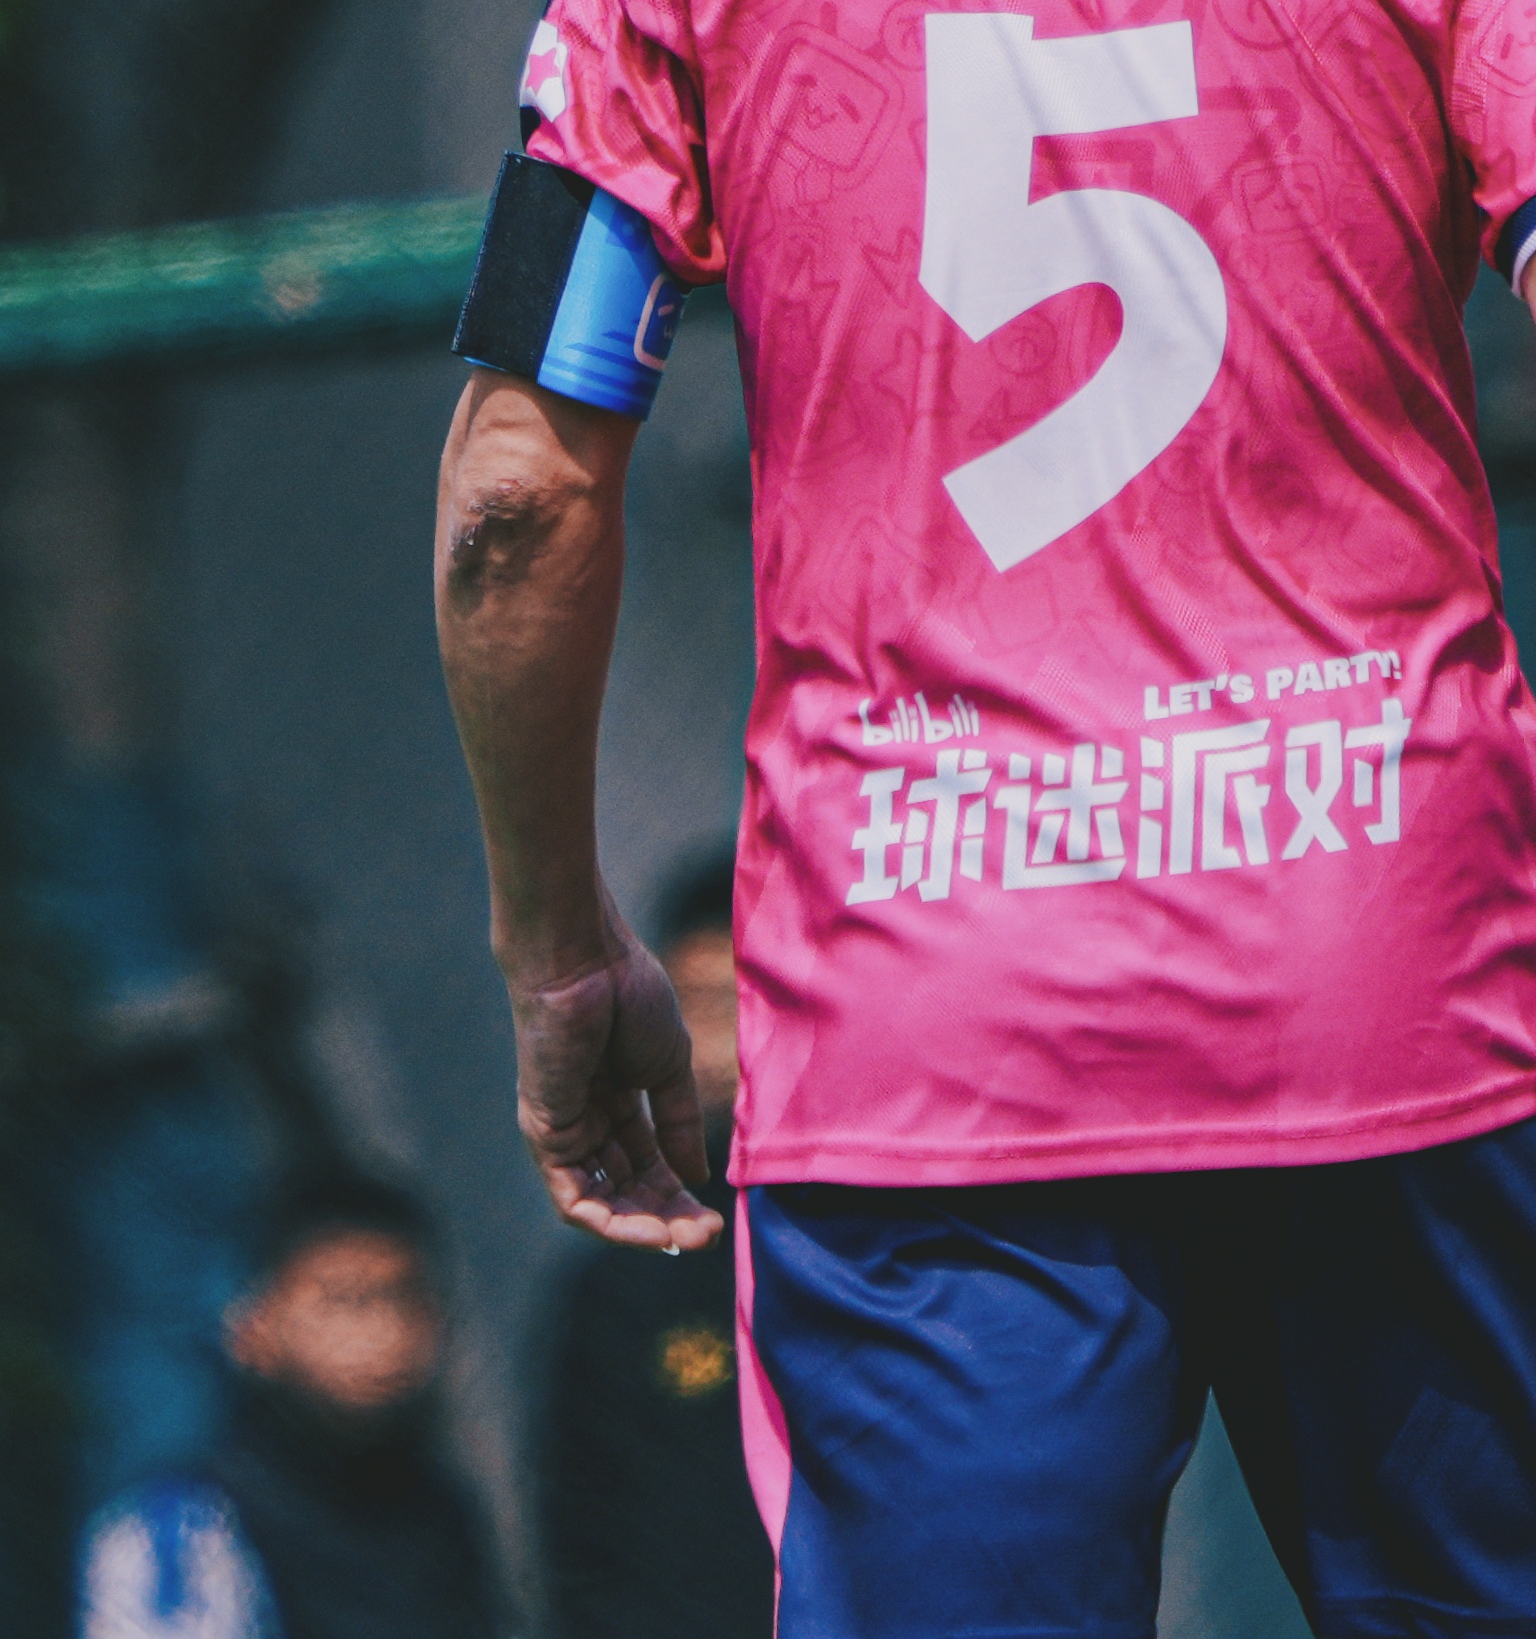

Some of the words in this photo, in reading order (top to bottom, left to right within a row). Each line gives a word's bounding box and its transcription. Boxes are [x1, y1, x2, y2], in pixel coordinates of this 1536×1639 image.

[918, 12, 1228, 574] 5
[858, 690, 981, 747] bilibili
[1143, 673, 1256, 721] LET'S
[1265, 649, 1403, 701] PARTY!
[844, 697, 1412, 907] 球迷派对
